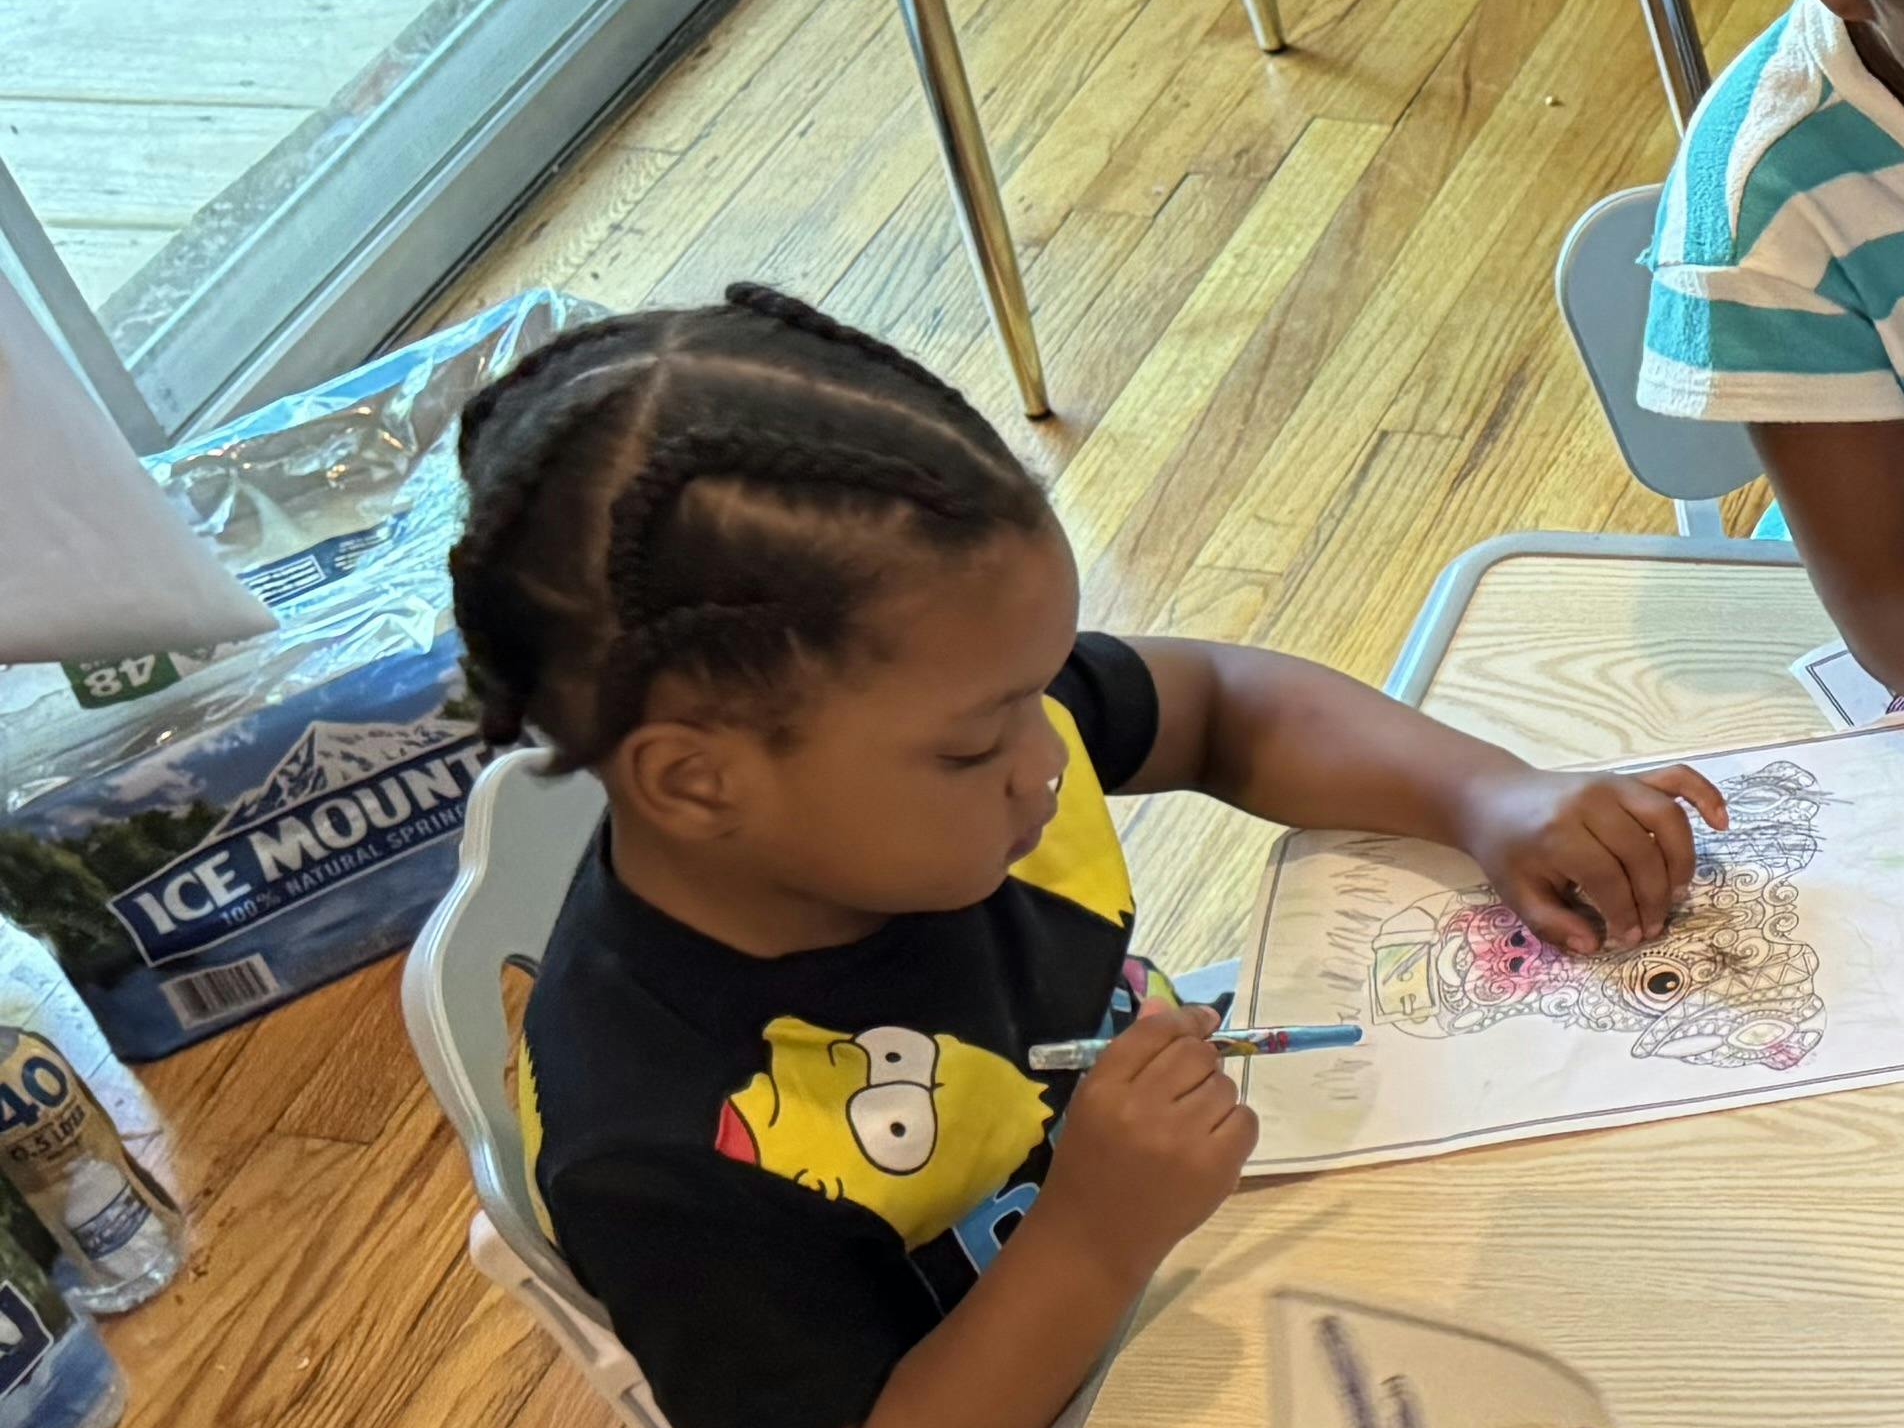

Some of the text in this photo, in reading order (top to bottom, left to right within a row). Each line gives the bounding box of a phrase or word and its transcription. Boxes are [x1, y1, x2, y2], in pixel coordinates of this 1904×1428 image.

[137, 850, 252, 935] ICE
[220, 892, 281, 929] 100%
[286, 842, 384, 896] NATURAL
